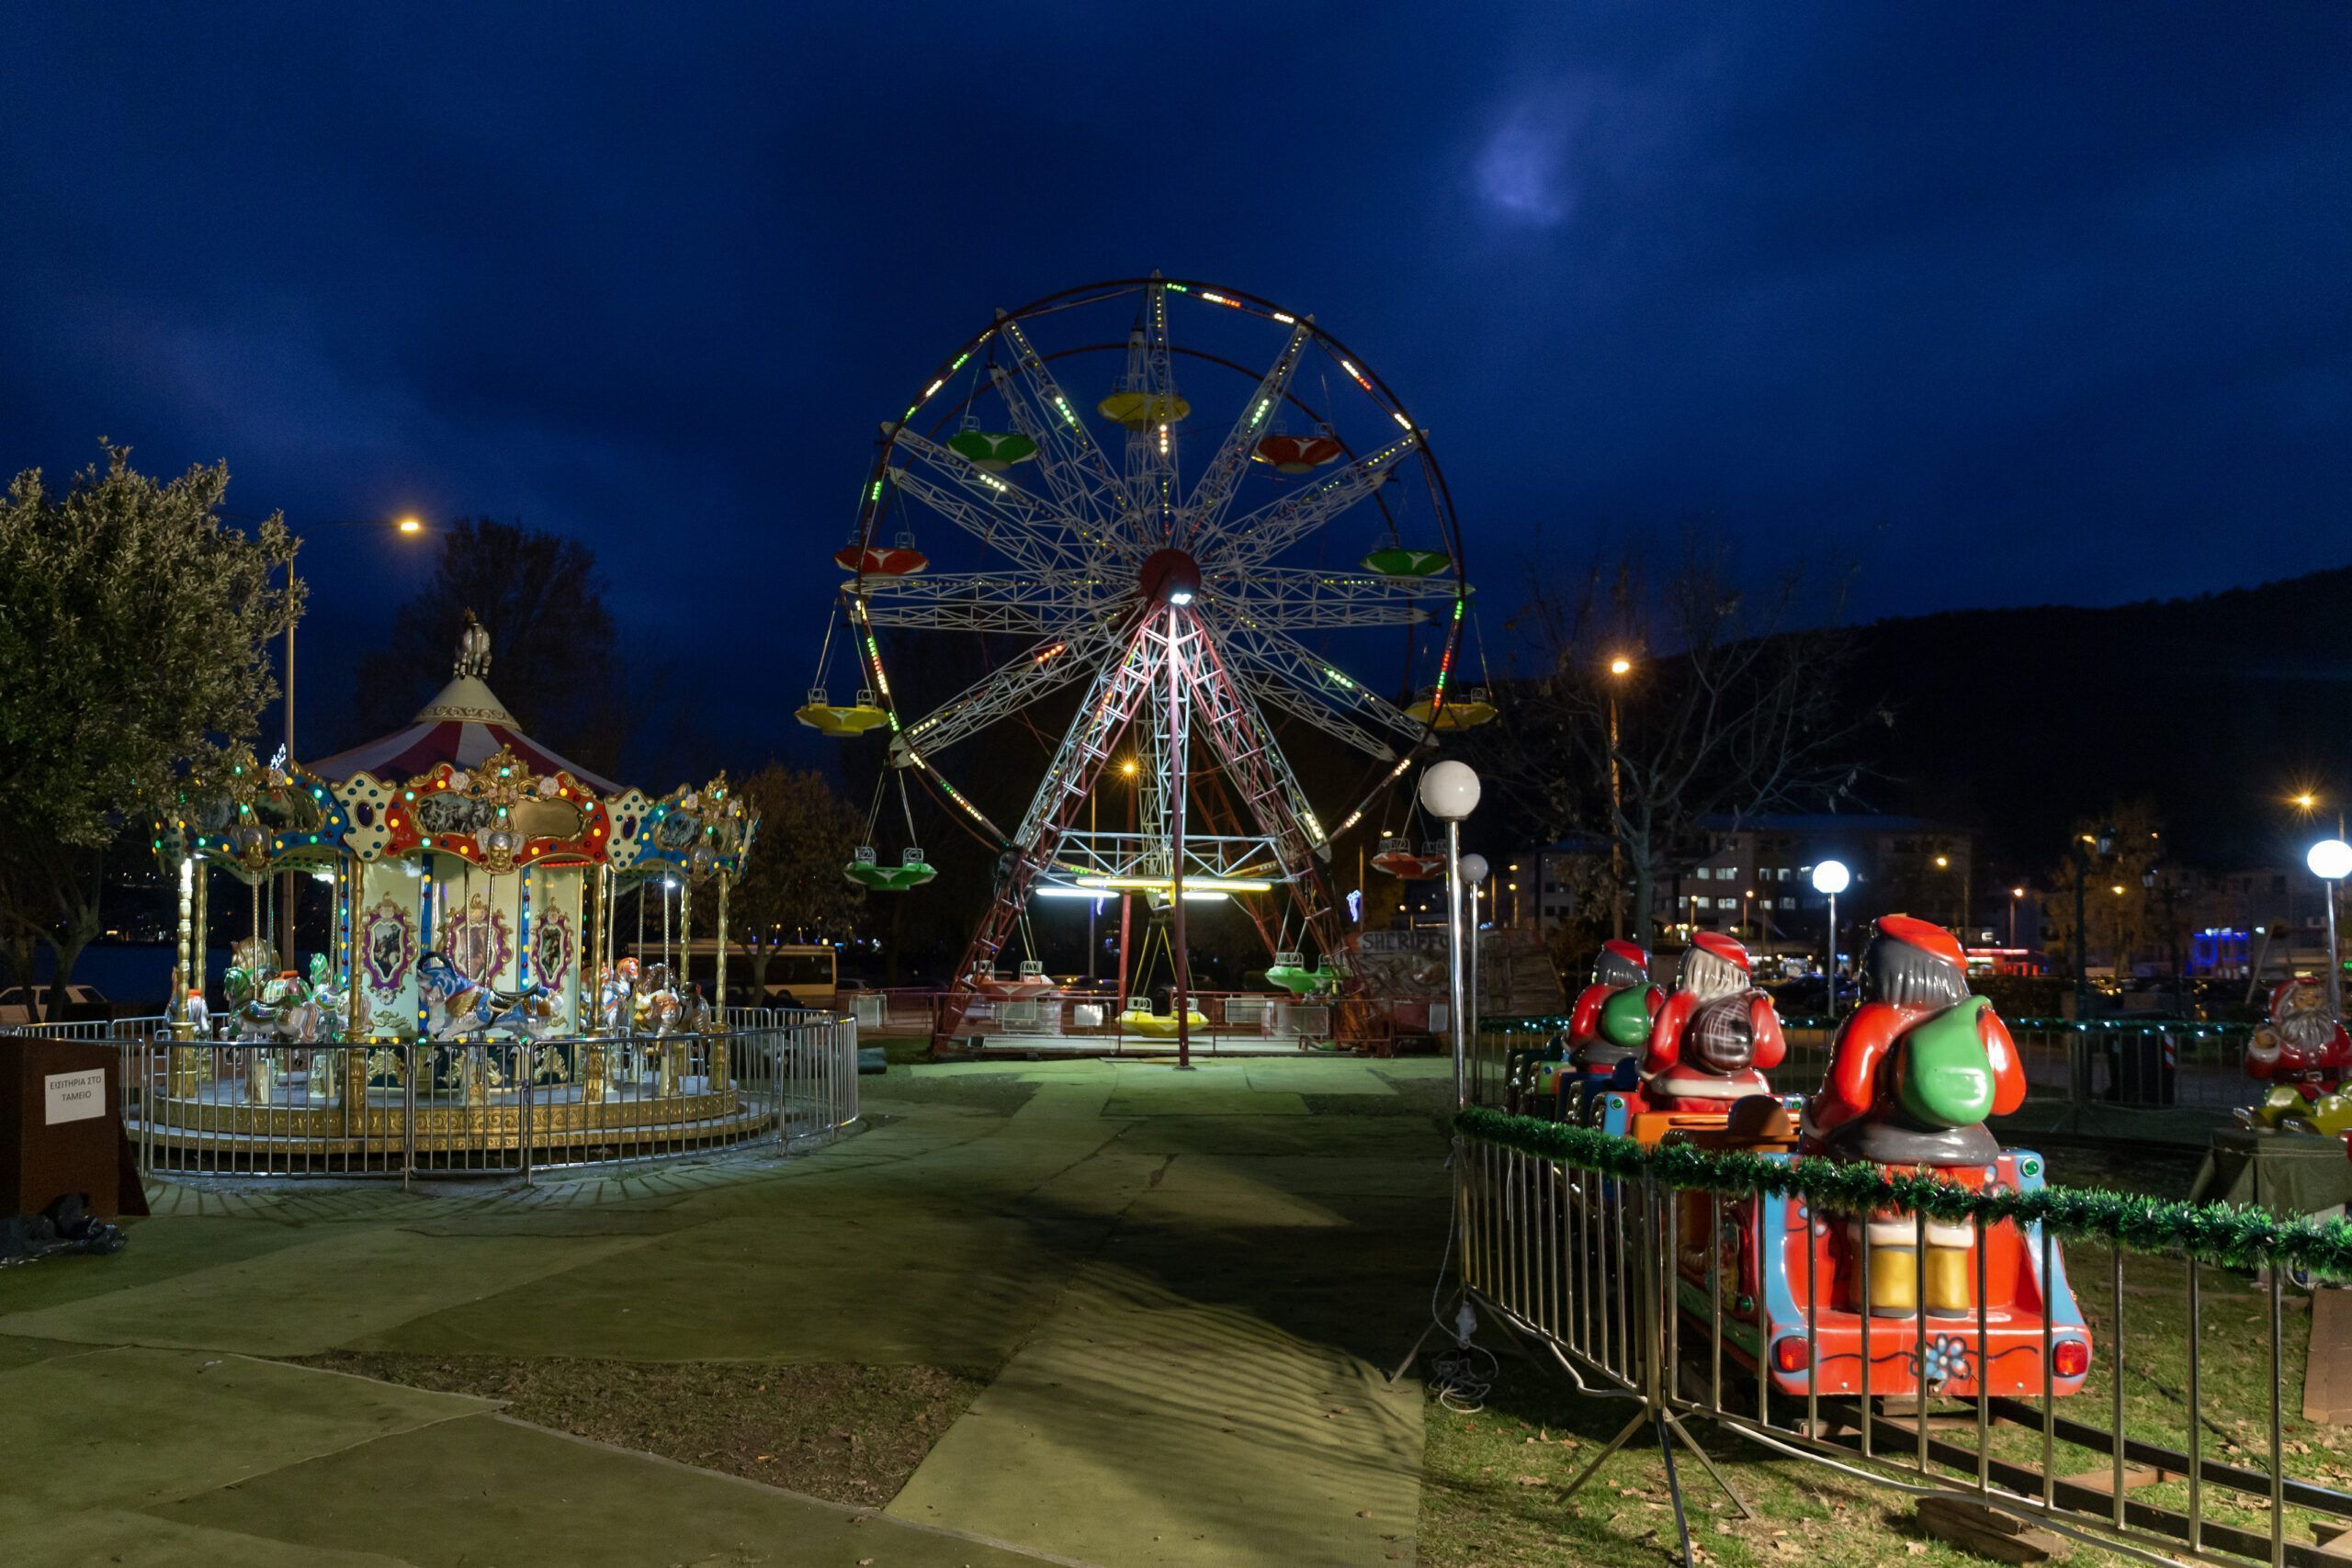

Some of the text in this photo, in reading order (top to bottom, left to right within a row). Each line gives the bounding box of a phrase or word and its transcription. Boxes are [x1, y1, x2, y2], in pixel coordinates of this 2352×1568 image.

[51, 1076, 101, 1089] ΕΙΣΙΤΗΡΙΑ ΣΤΟ
[62, 1090, 91, 1101] ΤΑΜΕΙΟ
